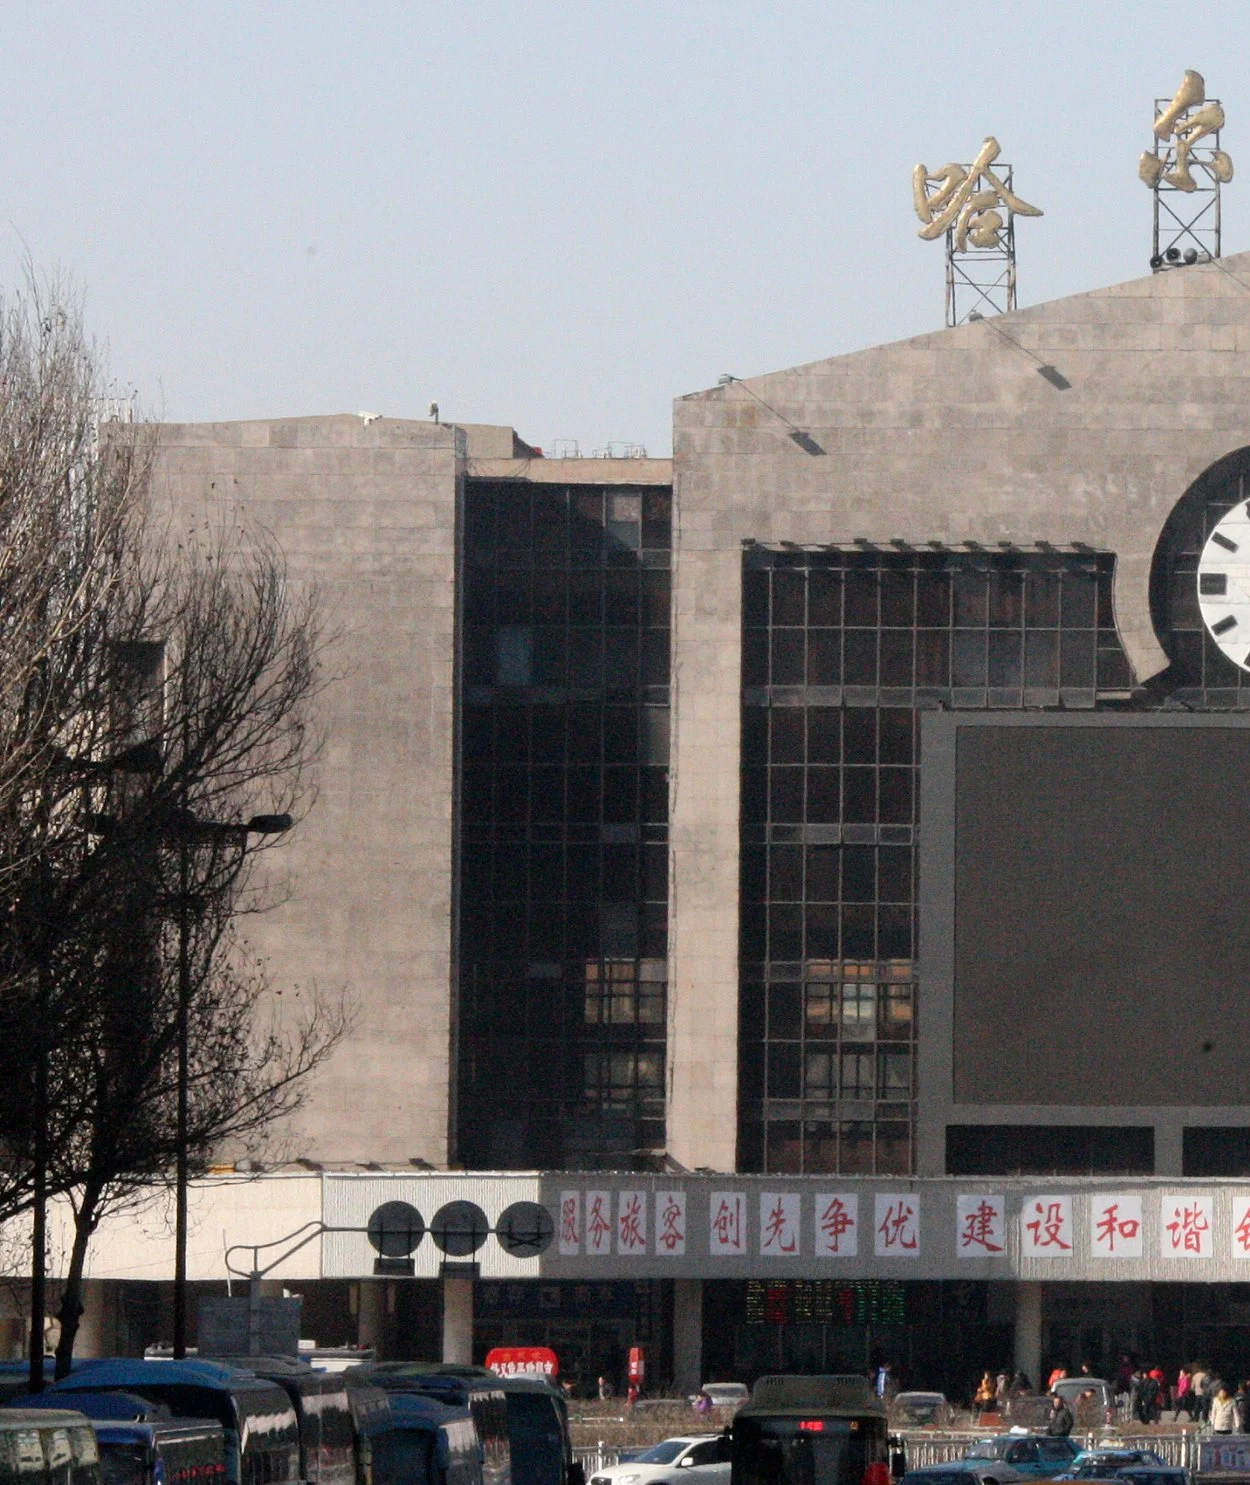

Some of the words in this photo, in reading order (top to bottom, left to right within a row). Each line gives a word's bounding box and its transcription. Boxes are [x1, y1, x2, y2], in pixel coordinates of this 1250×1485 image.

[562, 1194, 684, 1250] 服务旅客
[715, 1198, 920, 1252] 创先争优
